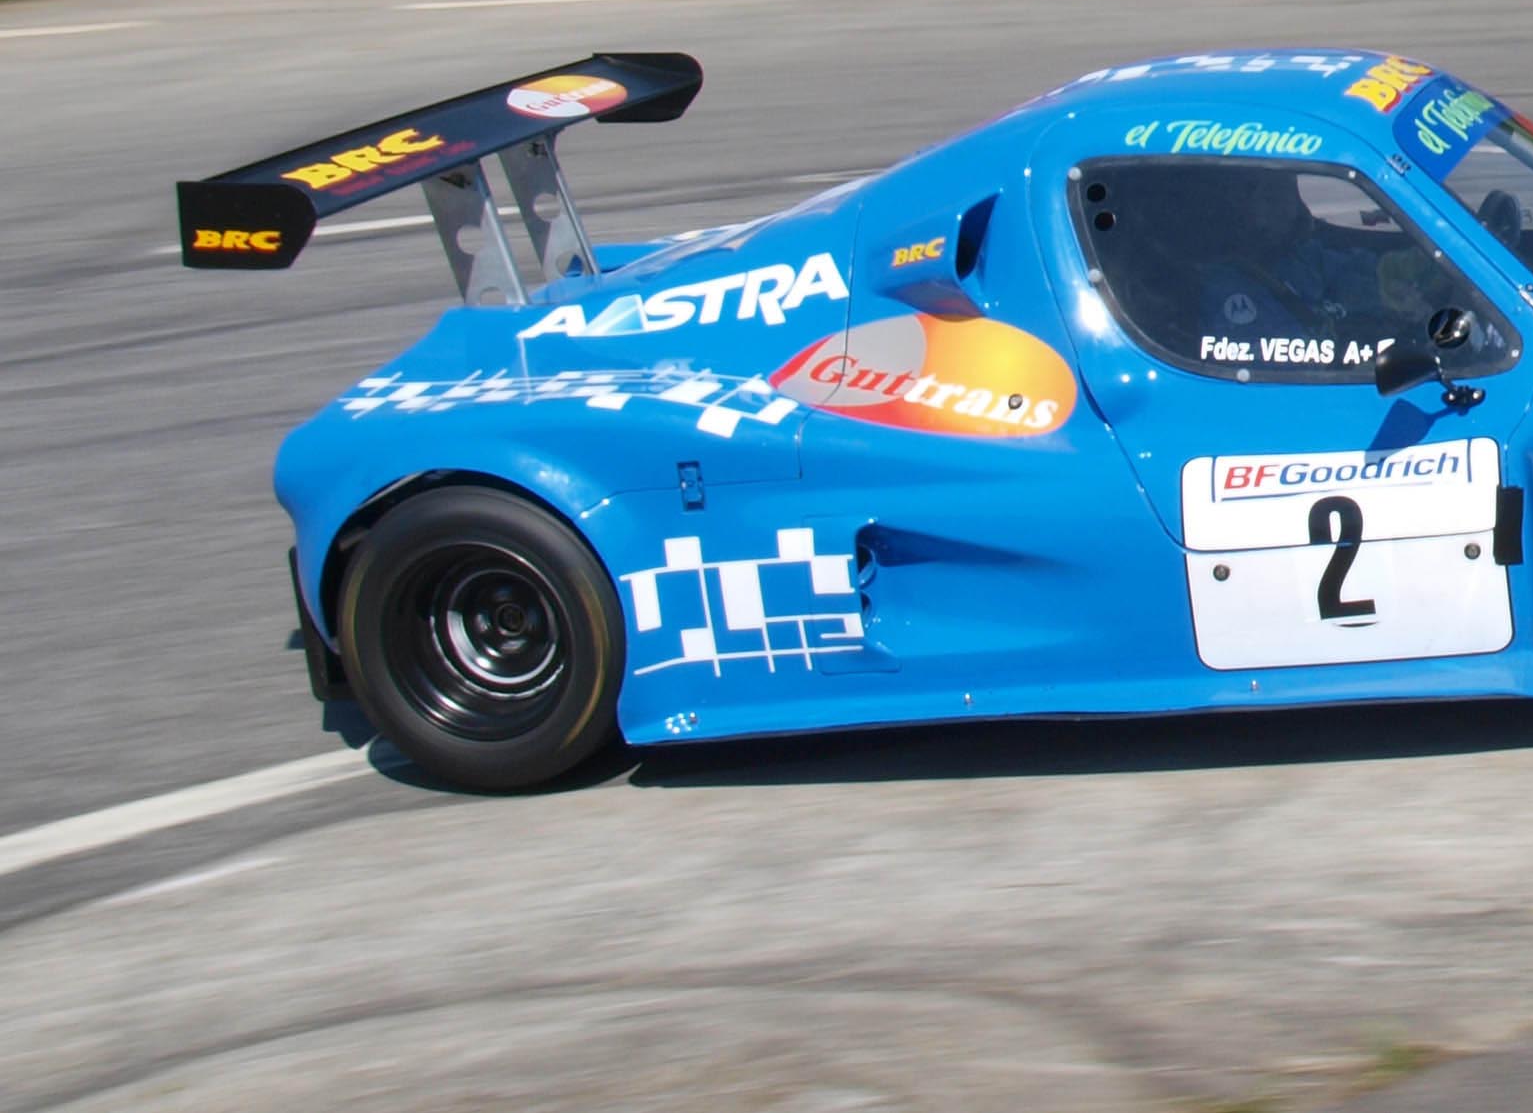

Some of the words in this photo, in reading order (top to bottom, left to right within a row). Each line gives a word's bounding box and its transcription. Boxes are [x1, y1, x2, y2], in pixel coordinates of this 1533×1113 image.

[1344, 55, 1434, 114] BRC
[1125, 120, 1160, 149] el
[279, 128, 446, 191] BRC
[192, 229, 283, 253] BRC
[891, 236, 947, 268] BRC
[1200, 336, 1255, 362] Fdez.
[1260, 337, 1335, 364] VEGAS
[809, 355, 1059, 428] Guttrans
[1223, 452, 1460, 491] BFGoodrich
[1308, 495, 1377, 621] 2
